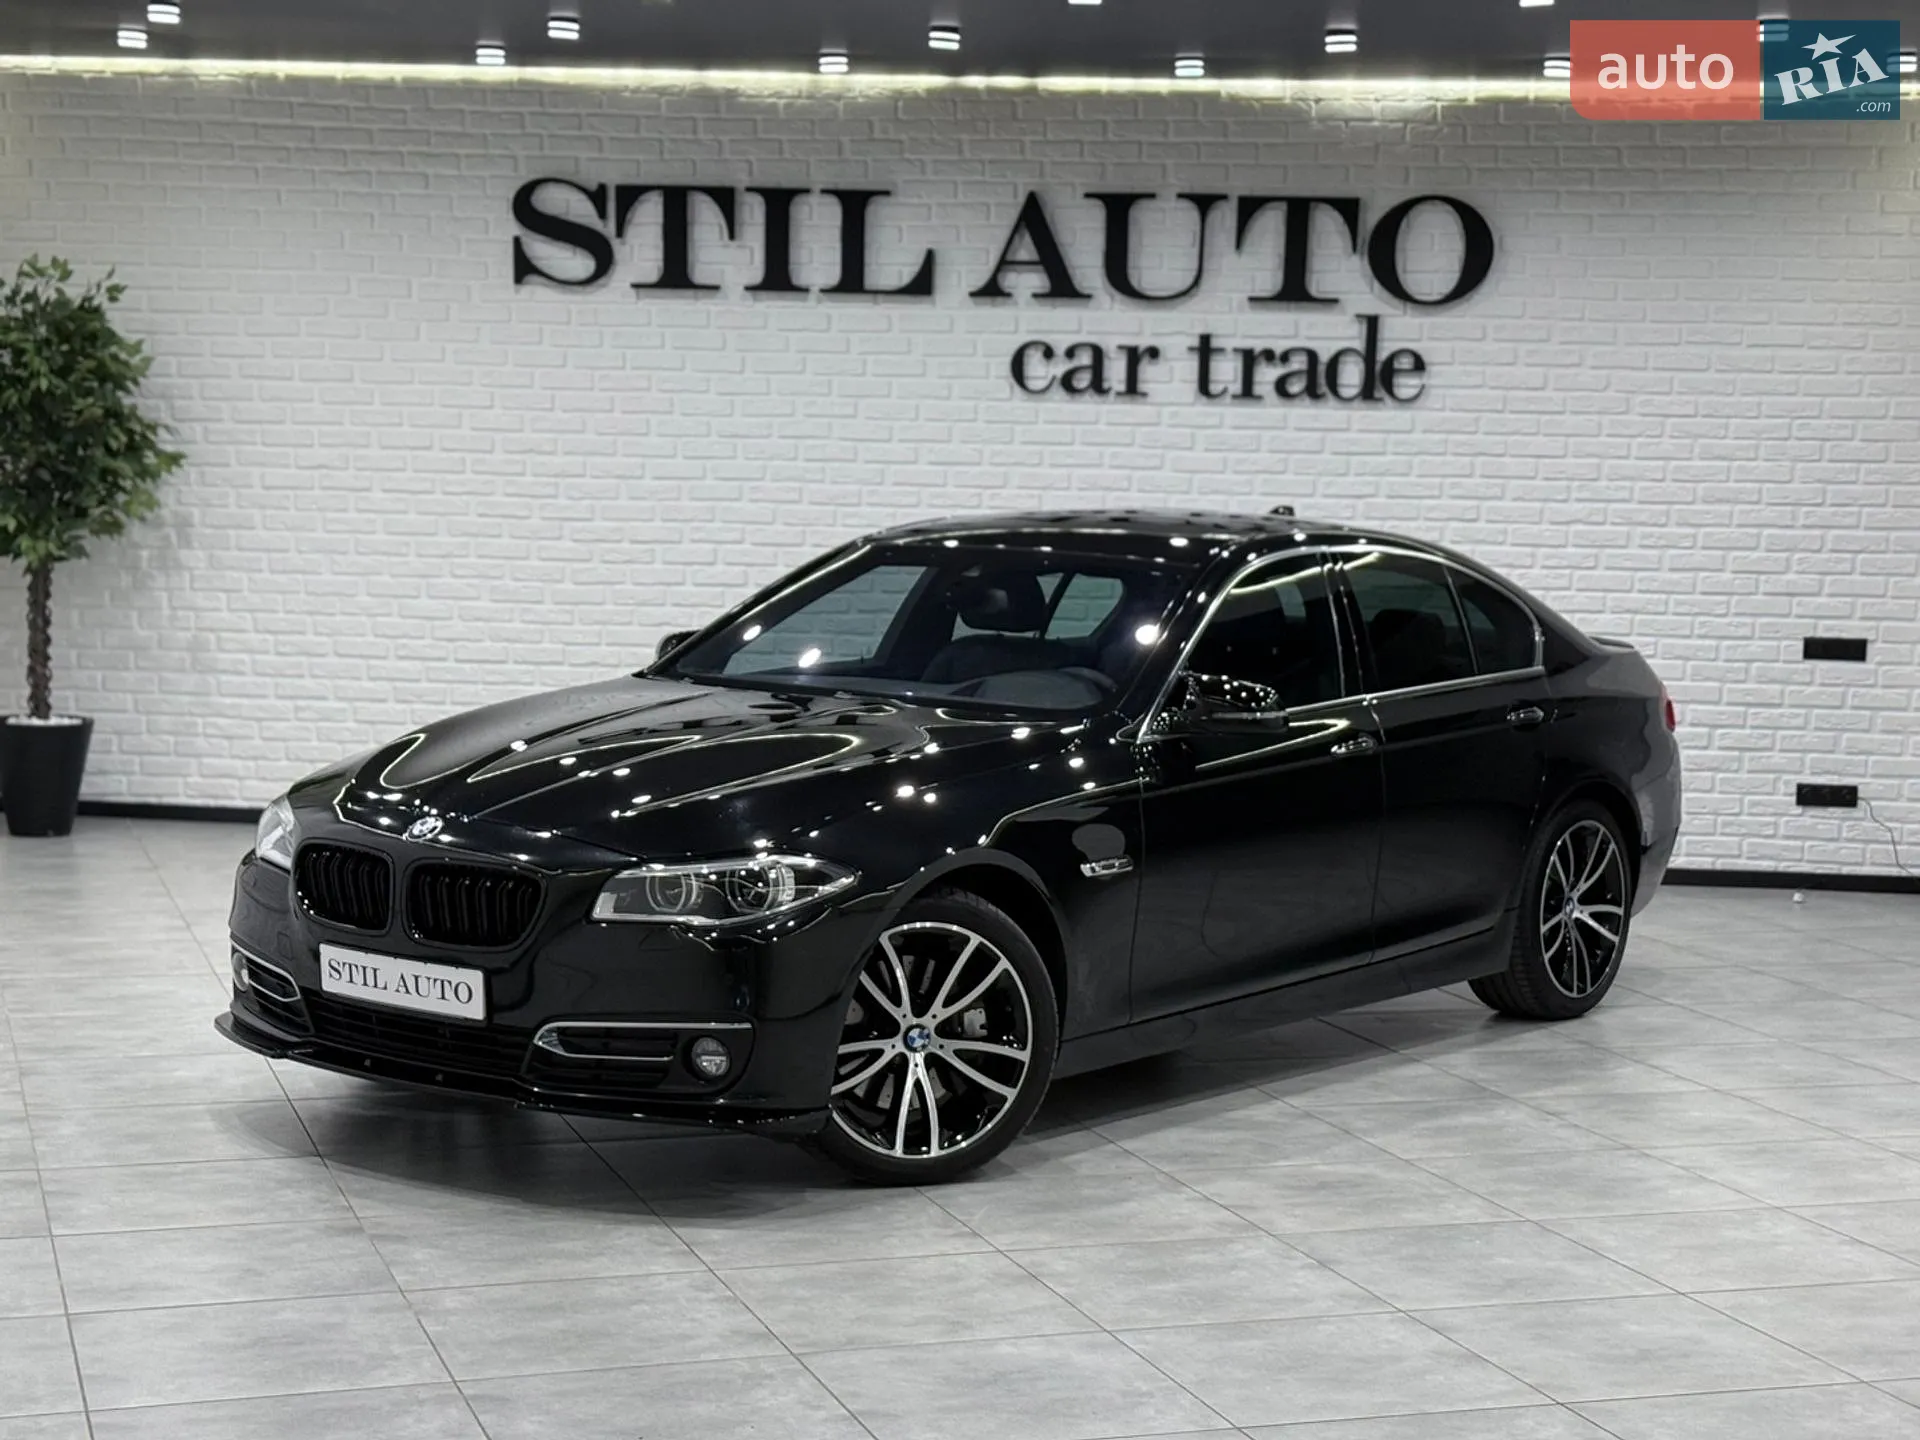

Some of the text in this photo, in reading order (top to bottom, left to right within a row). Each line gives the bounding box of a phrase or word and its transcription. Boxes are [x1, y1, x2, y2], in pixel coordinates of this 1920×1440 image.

[512, 177, 1495, 307] STIL AUTO
[1010, 315, 1428, 403] car trade
[327, 958, 473, 1005] STIL AUTO
